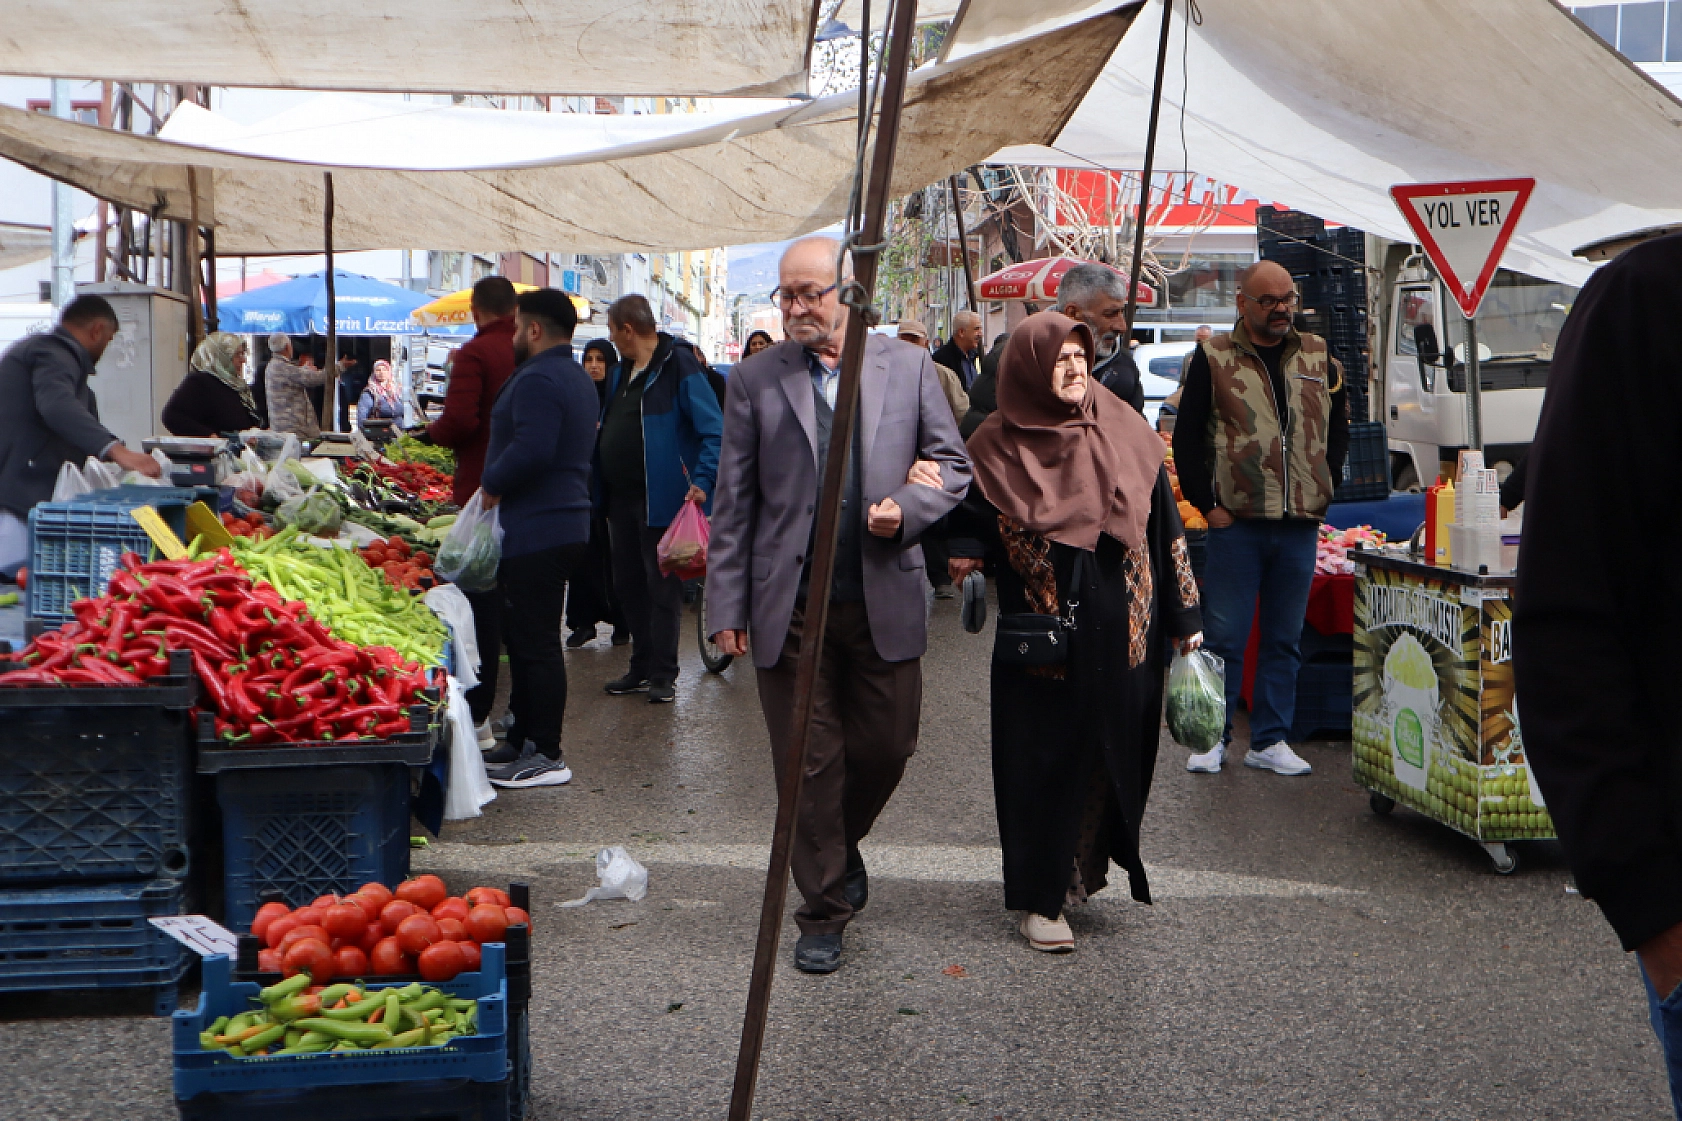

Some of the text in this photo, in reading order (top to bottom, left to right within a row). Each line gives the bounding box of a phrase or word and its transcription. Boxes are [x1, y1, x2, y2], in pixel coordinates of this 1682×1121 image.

[1423, 198, 1501, 229] YOL VER
[988, 284, 1019, 295] ALGIDA
